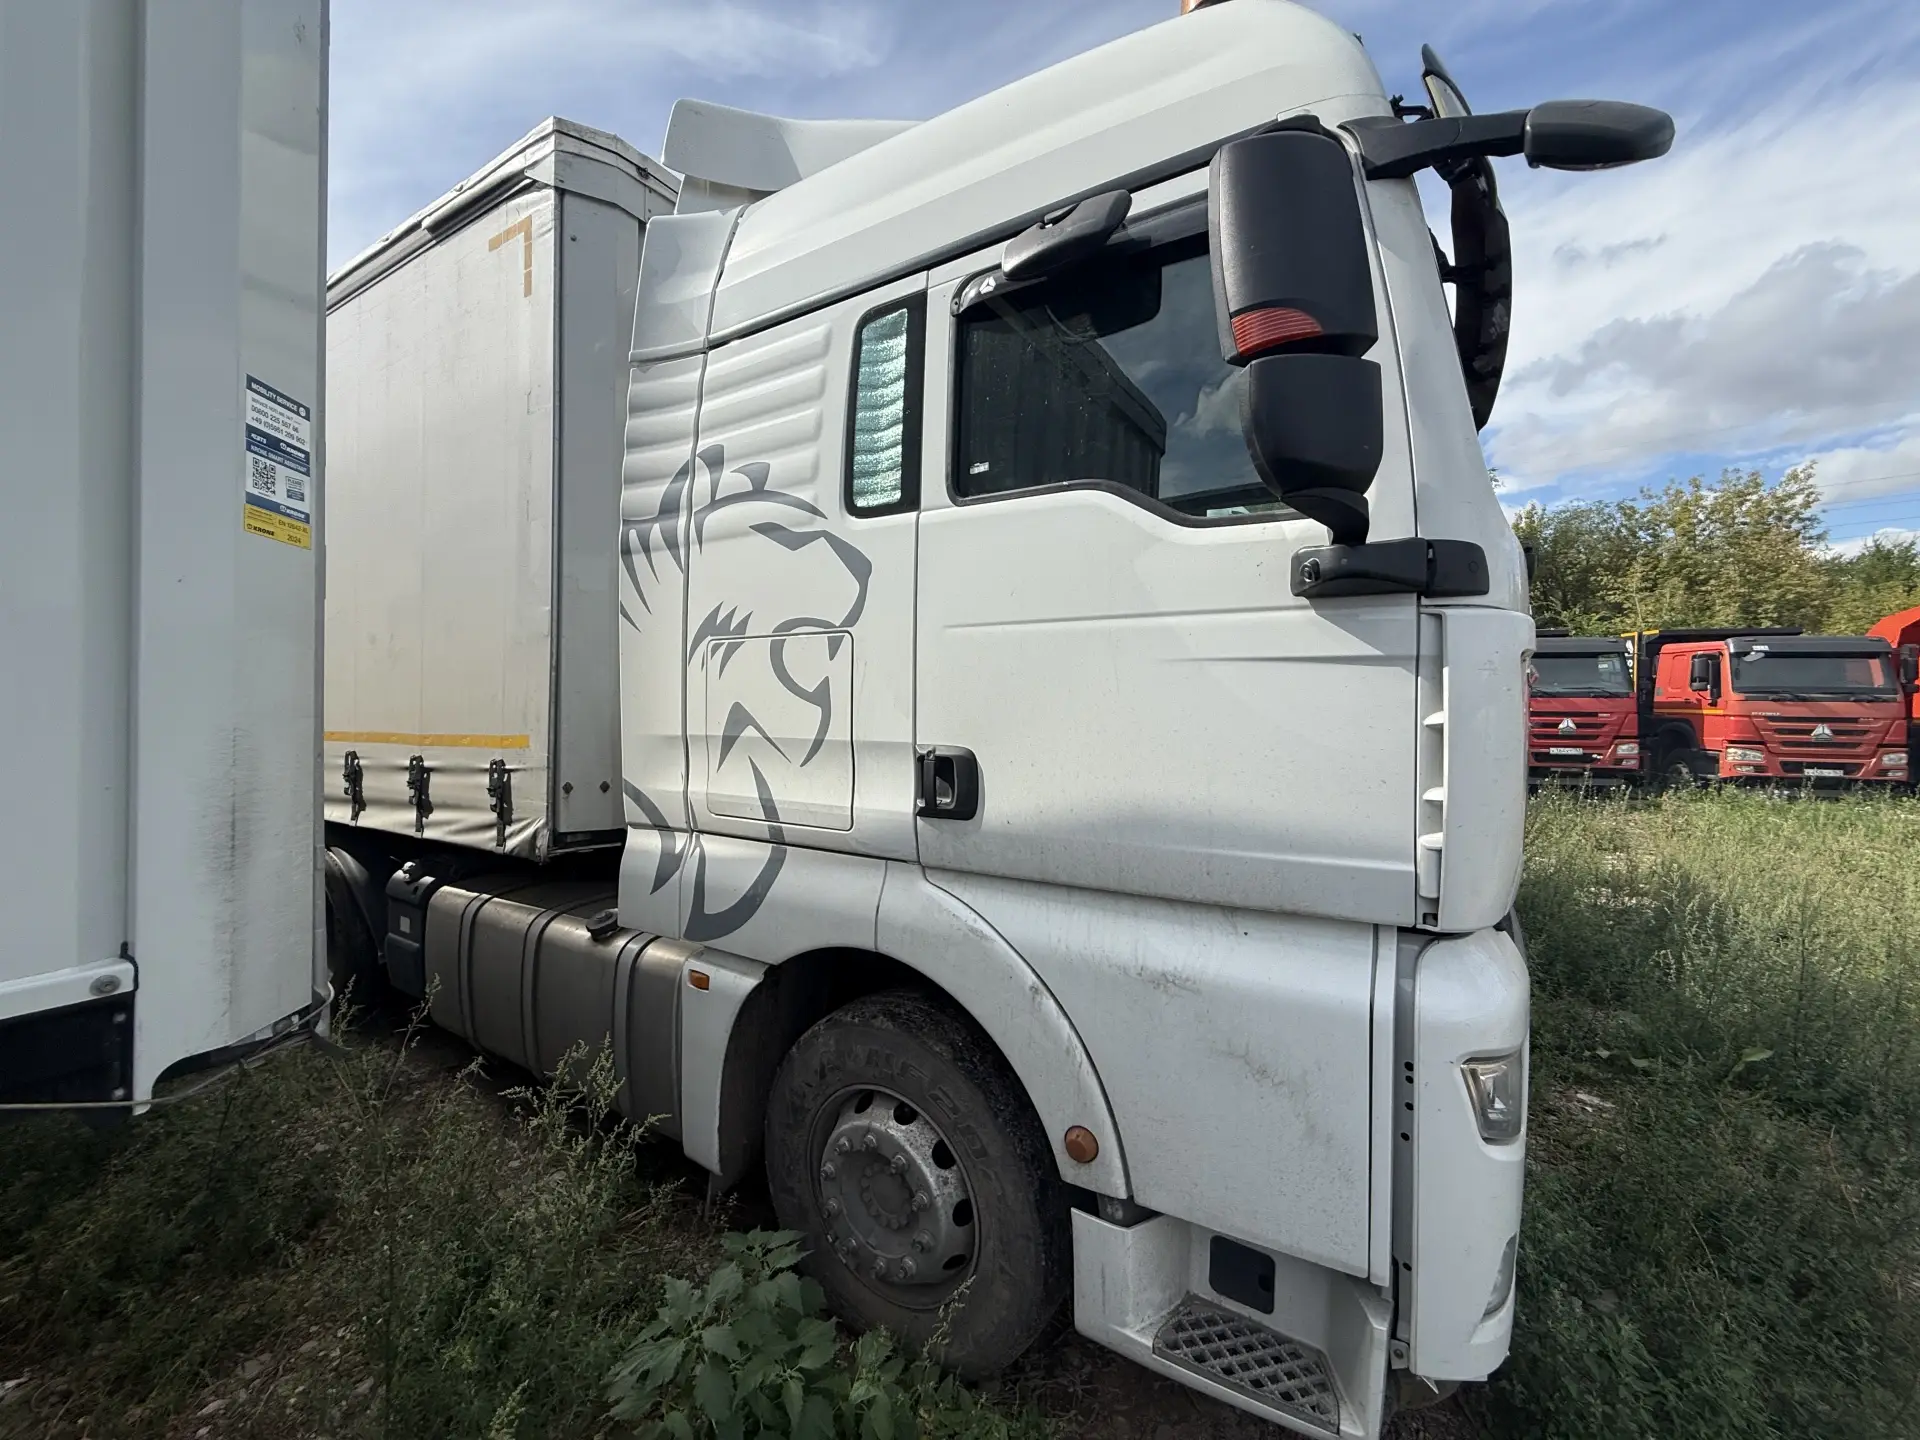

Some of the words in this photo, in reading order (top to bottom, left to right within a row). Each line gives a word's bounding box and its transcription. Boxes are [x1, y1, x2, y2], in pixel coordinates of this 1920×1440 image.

[251, 382, 277, 400] MOBILITY
[276, 395, 298, 412] SERVICE
[251, 416, 262, 425] +49
[286, 447, 305, 459] KRONE
[252, 525, 275, 536] KRONE
[287, 534, 301, 544] 2024
